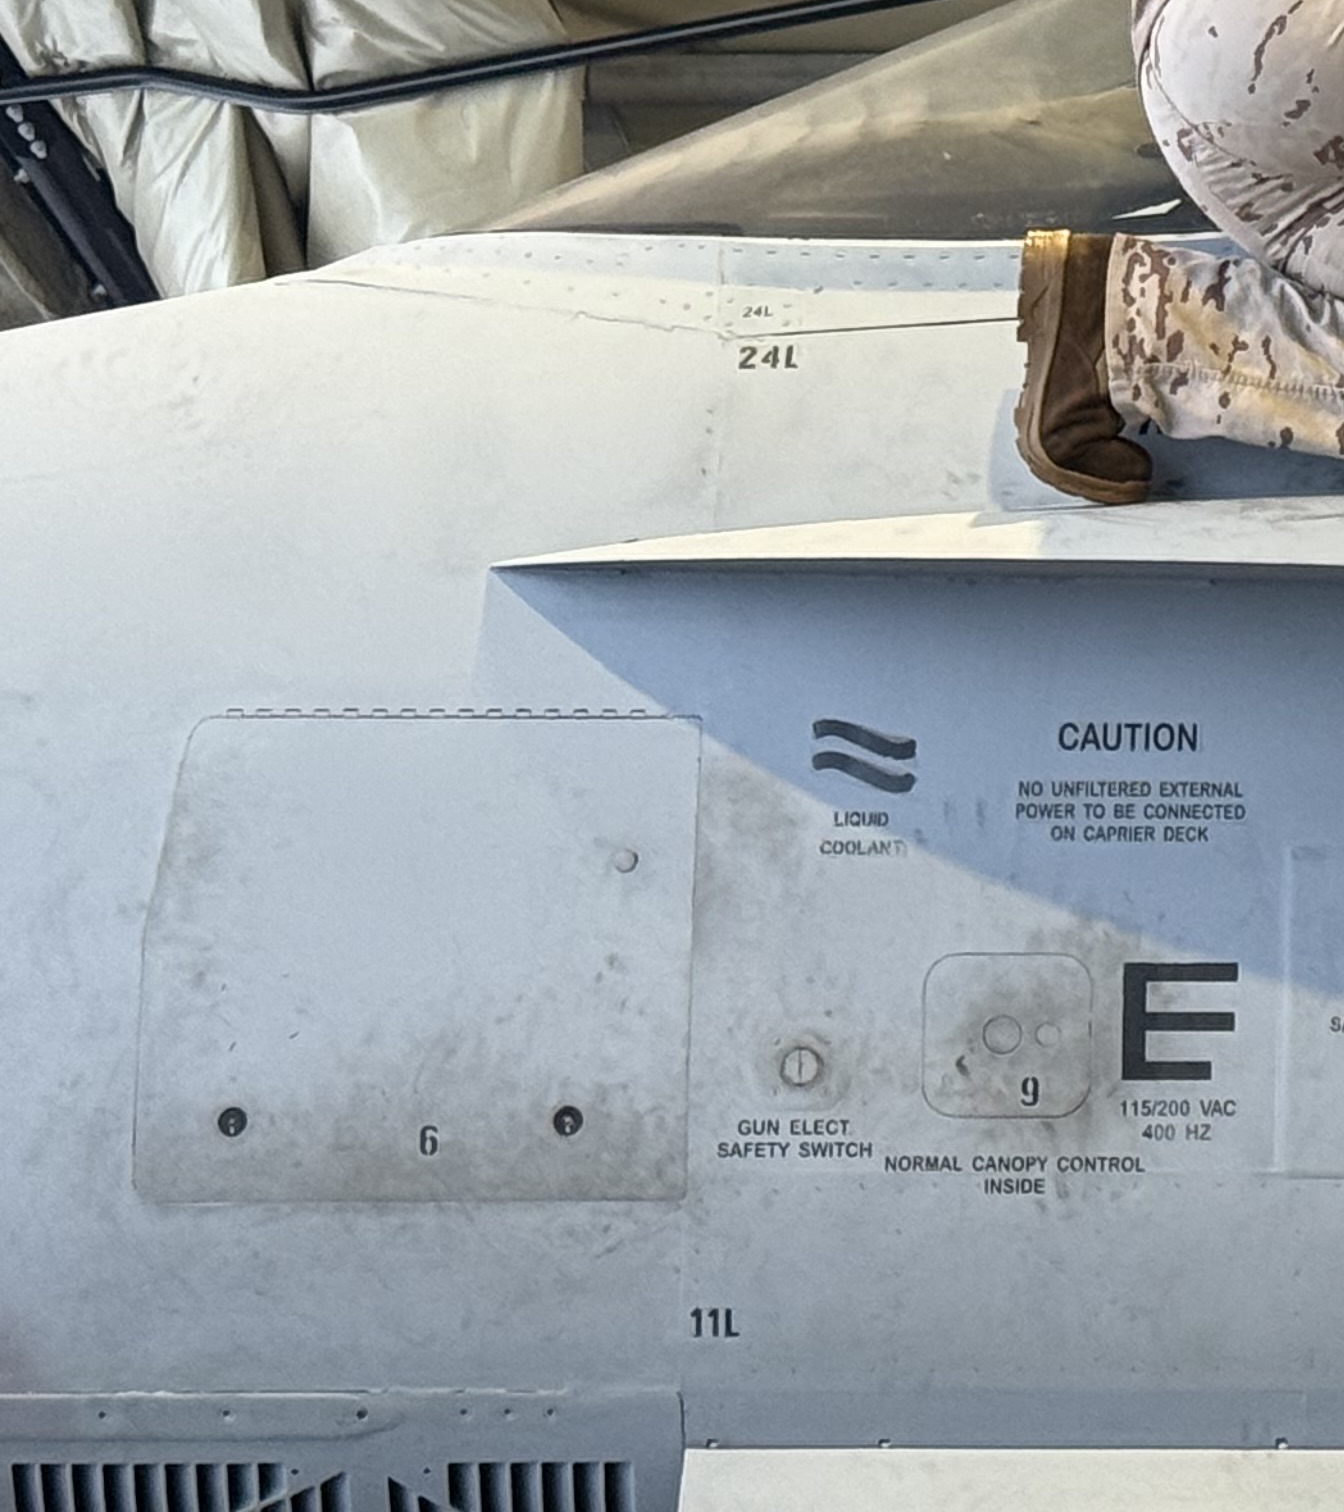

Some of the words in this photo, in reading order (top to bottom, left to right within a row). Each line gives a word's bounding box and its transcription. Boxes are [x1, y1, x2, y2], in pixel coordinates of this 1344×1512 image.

[742, 304, 774, 318] 24L
[738, 344, 799, 370] 24L
[1058, 721, 1199, 753] CAUTION
[1018, 780, 1043, 797] NO
[1051, 780, 1151, 797] UNFILTERED
[1159, 781, 1243, 797] EXTERNAL
[833, 810, 890, 827] LIQUID
[1015, 803, 1075, 819] POWER
[1083, 803, 1105, 819] TO
[1113, 803, 1136, 819] BE
[1143, 803, 1246, 820] CONNECTED
[1049, 826, 1075, 842] ON
[1163, 826, 1209, 842] DECK
[1120, 961, 1240, 1082] E
[1019, 1076, 1042, 1107] 9
[1120, 1099, 1190, 1118] 115/200
[1199, 1100, 1237, 1117] VAC
[737, 1119, 780, 1136] GUN
[1141, 1123, 1176, 1141] 400
[1185, 1123, 1212, 1141] HZ
[418, 1125, 440, 1157] 6
[717, 1141, 790, 1159] SAFETY
[798, 1141, 873, 1159] SWITCH
[884, 1155, 962, 1173] NORMAL
[972, 1155, 1048, 1173] CANOPY
[1056, 1155, 1146, 1173] CONTROL
[983, 1177, 1046, 1195] INSIDE
[689, 1307, 740, 1339] 11L
